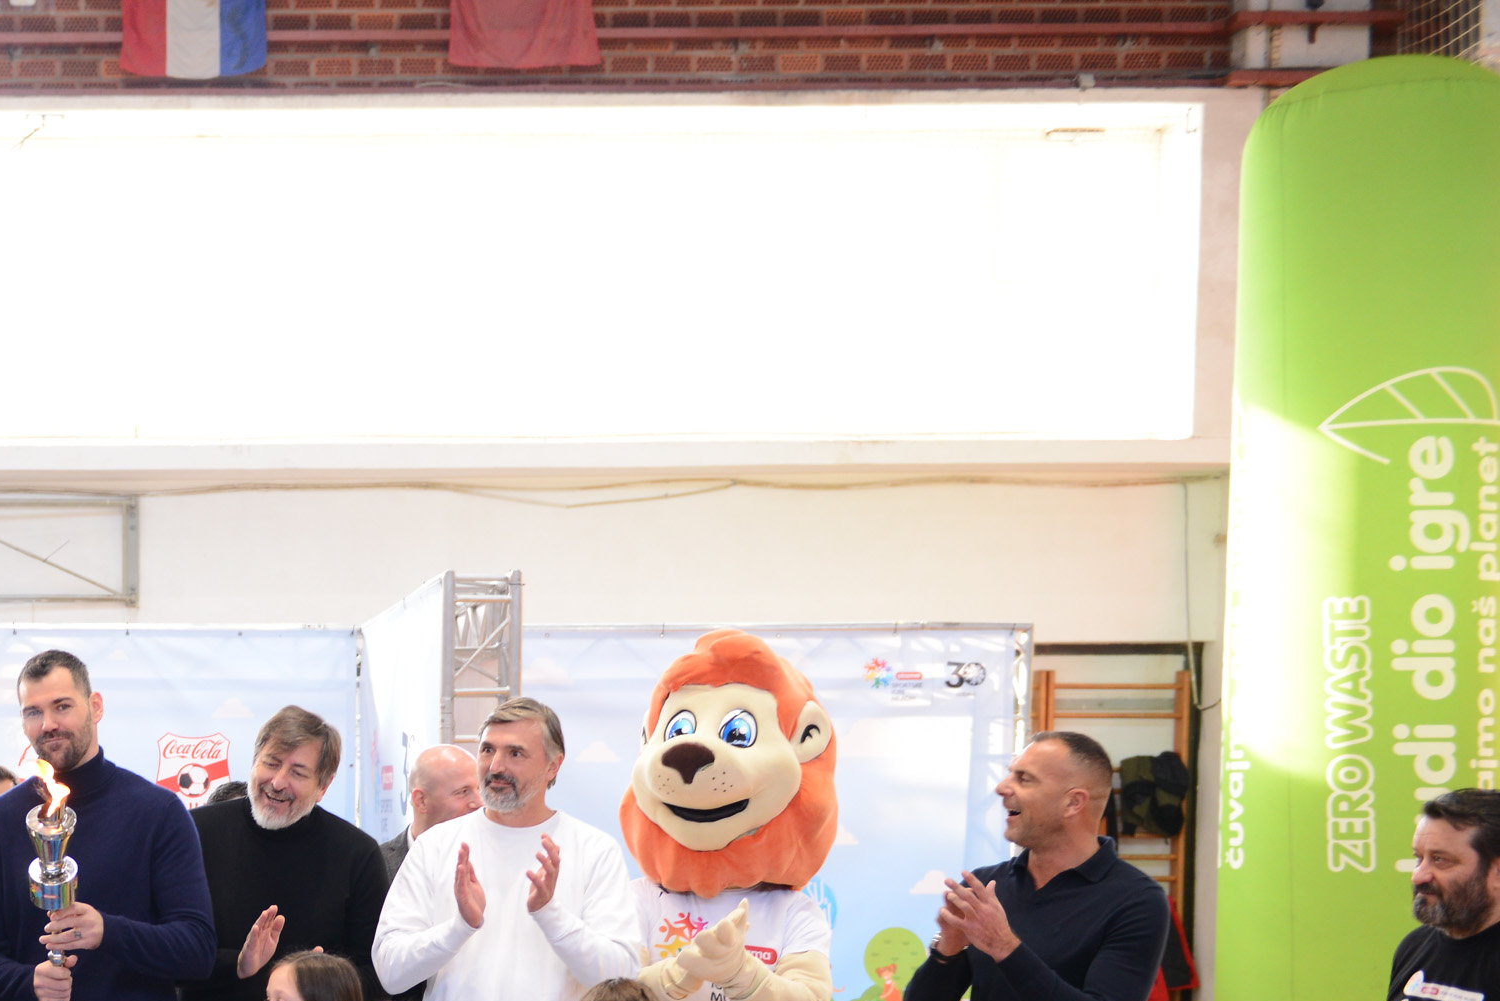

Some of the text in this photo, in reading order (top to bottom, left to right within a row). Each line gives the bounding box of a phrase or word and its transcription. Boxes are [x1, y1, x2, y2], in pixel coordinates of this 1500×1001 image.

[1388, 435, 1471, 571] igre
[1469, 436, 1500, 581] planet
[1390, 594, 1457, 700] dio
[1471, 596, 1497, 673] naš
[163, 739, 224, 760] Coca-Cola
[1322, 595, 1377, 873] ZERO WASTE
